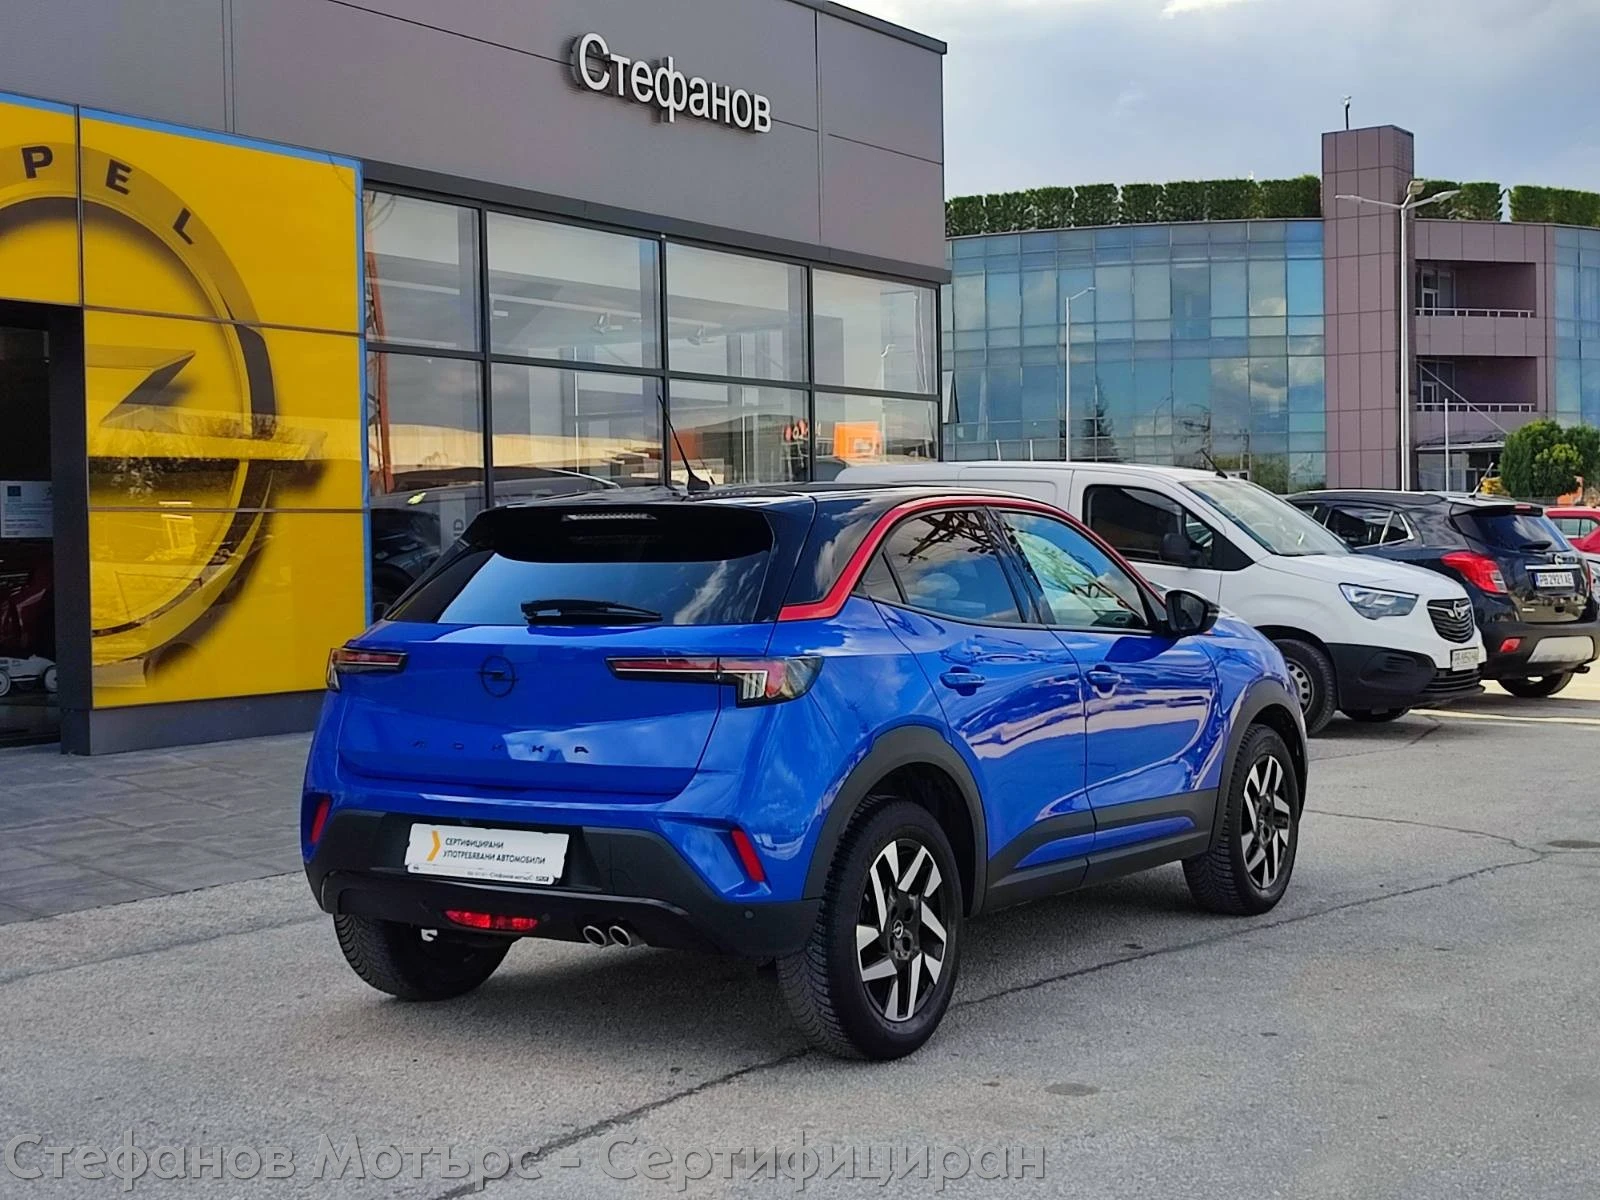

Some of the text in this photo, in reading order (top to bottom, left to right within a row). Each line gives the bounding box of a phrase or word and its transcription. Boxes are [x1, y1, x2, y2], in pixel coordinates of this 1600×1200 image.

[578, 32, 772, 134] Стефанов
[445, 837, 505, 849] СЕРТИФИЦИРАНИ
[442, 849, 546, 864] УПОТРЕБЯВАНИ АВТОМОБИЛИ
